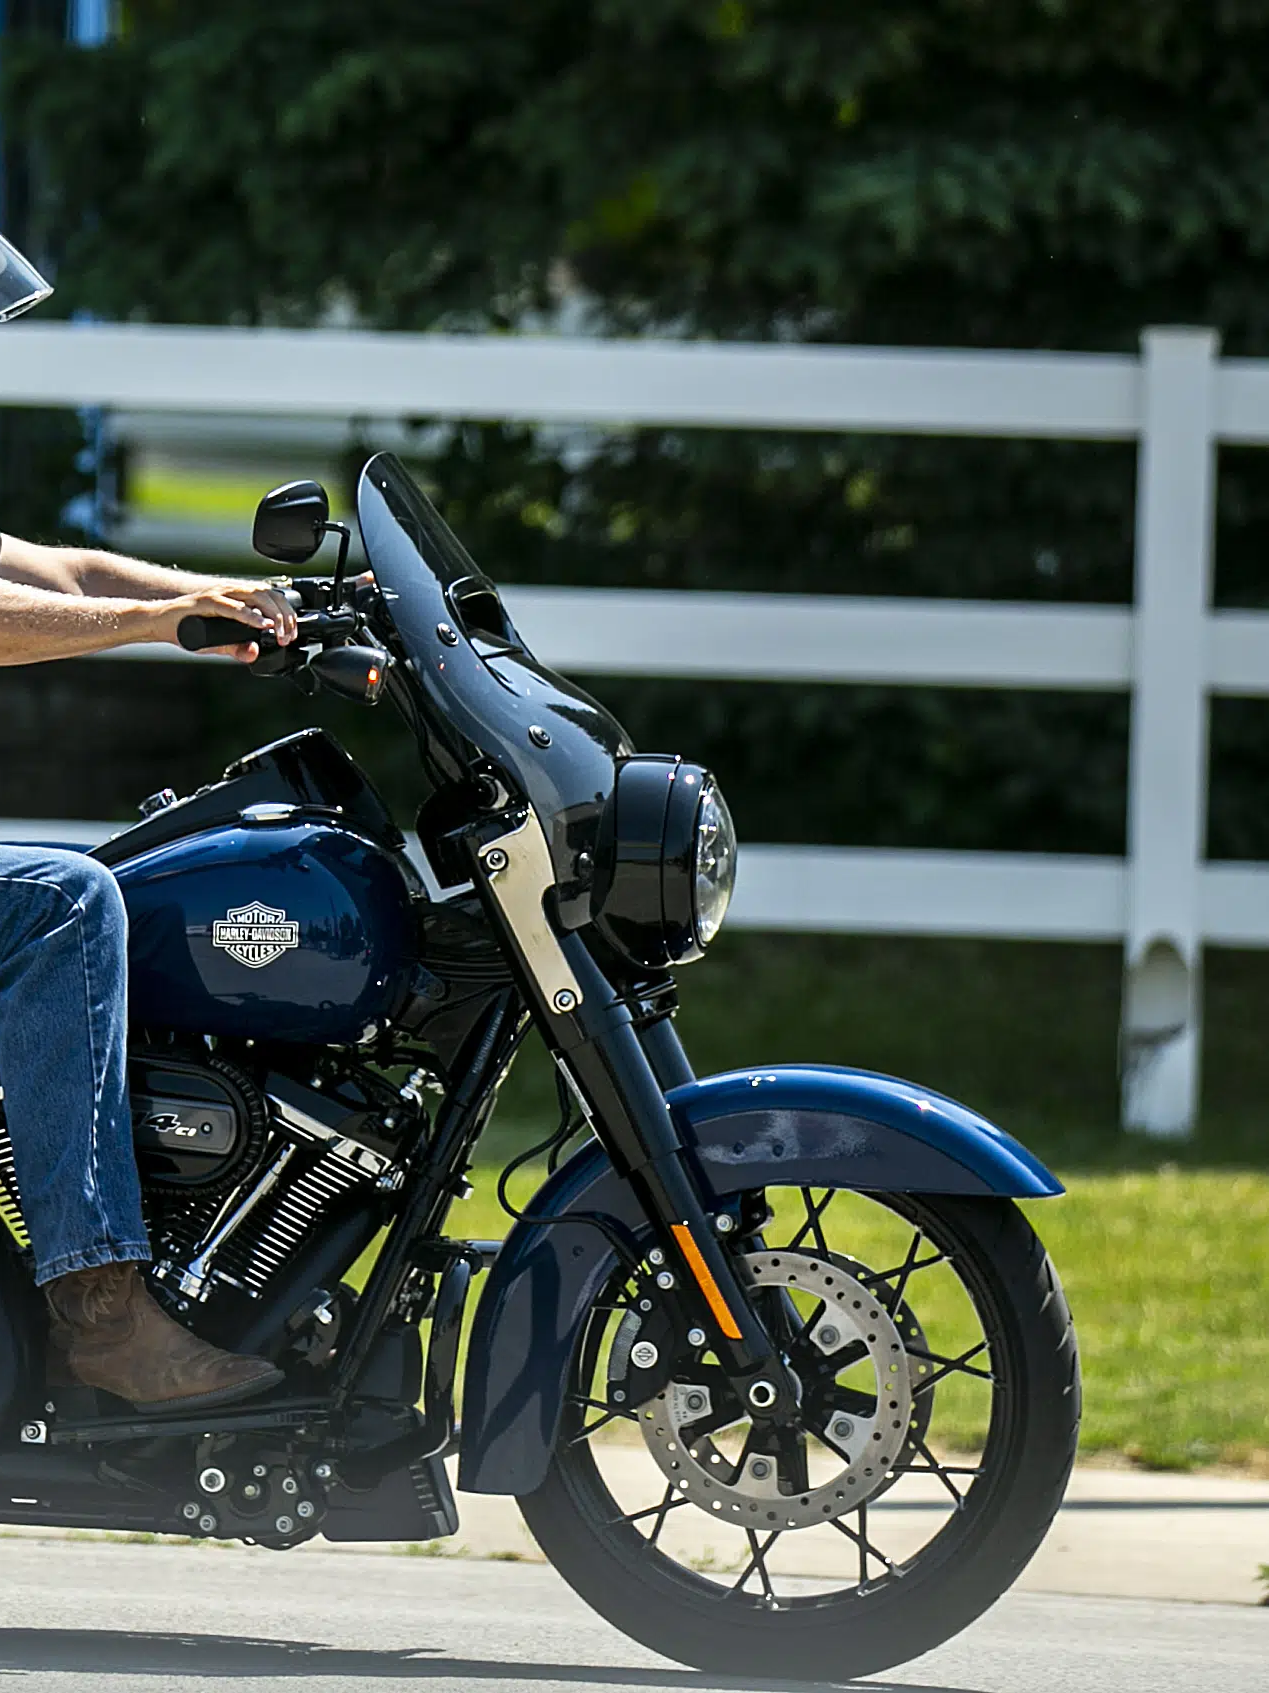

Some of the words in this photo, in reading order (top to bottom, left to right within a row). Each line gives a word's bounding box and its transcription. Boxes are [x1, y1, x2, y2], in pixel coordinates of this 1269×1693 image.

[236, 909, 275, 924] MOTOR
[220, 927, 292, 941] HARLEY-DAVIDSON
[235, 944, 275, 961] CYCLES
